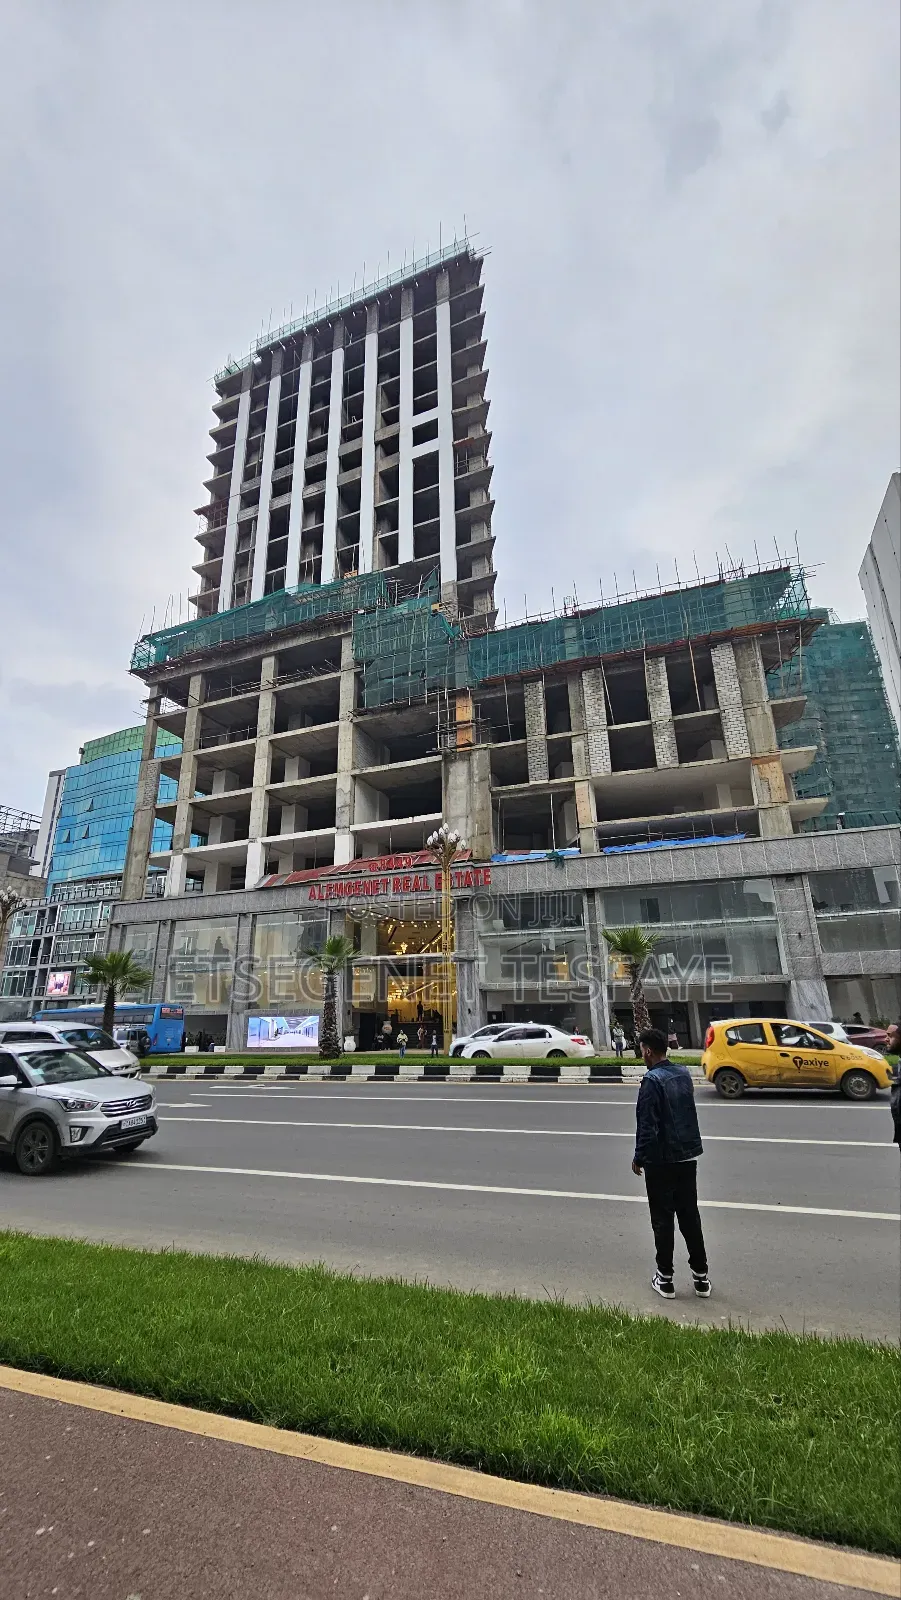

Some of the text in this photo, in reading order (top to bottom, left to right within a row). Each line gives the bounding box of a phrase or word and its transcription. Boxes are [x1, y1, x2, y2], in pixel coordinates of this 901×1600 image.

[308, 867, 492, 901] ALEMGENET REAL ETATE
[792, 1056, 829, 1071] Taxiye
